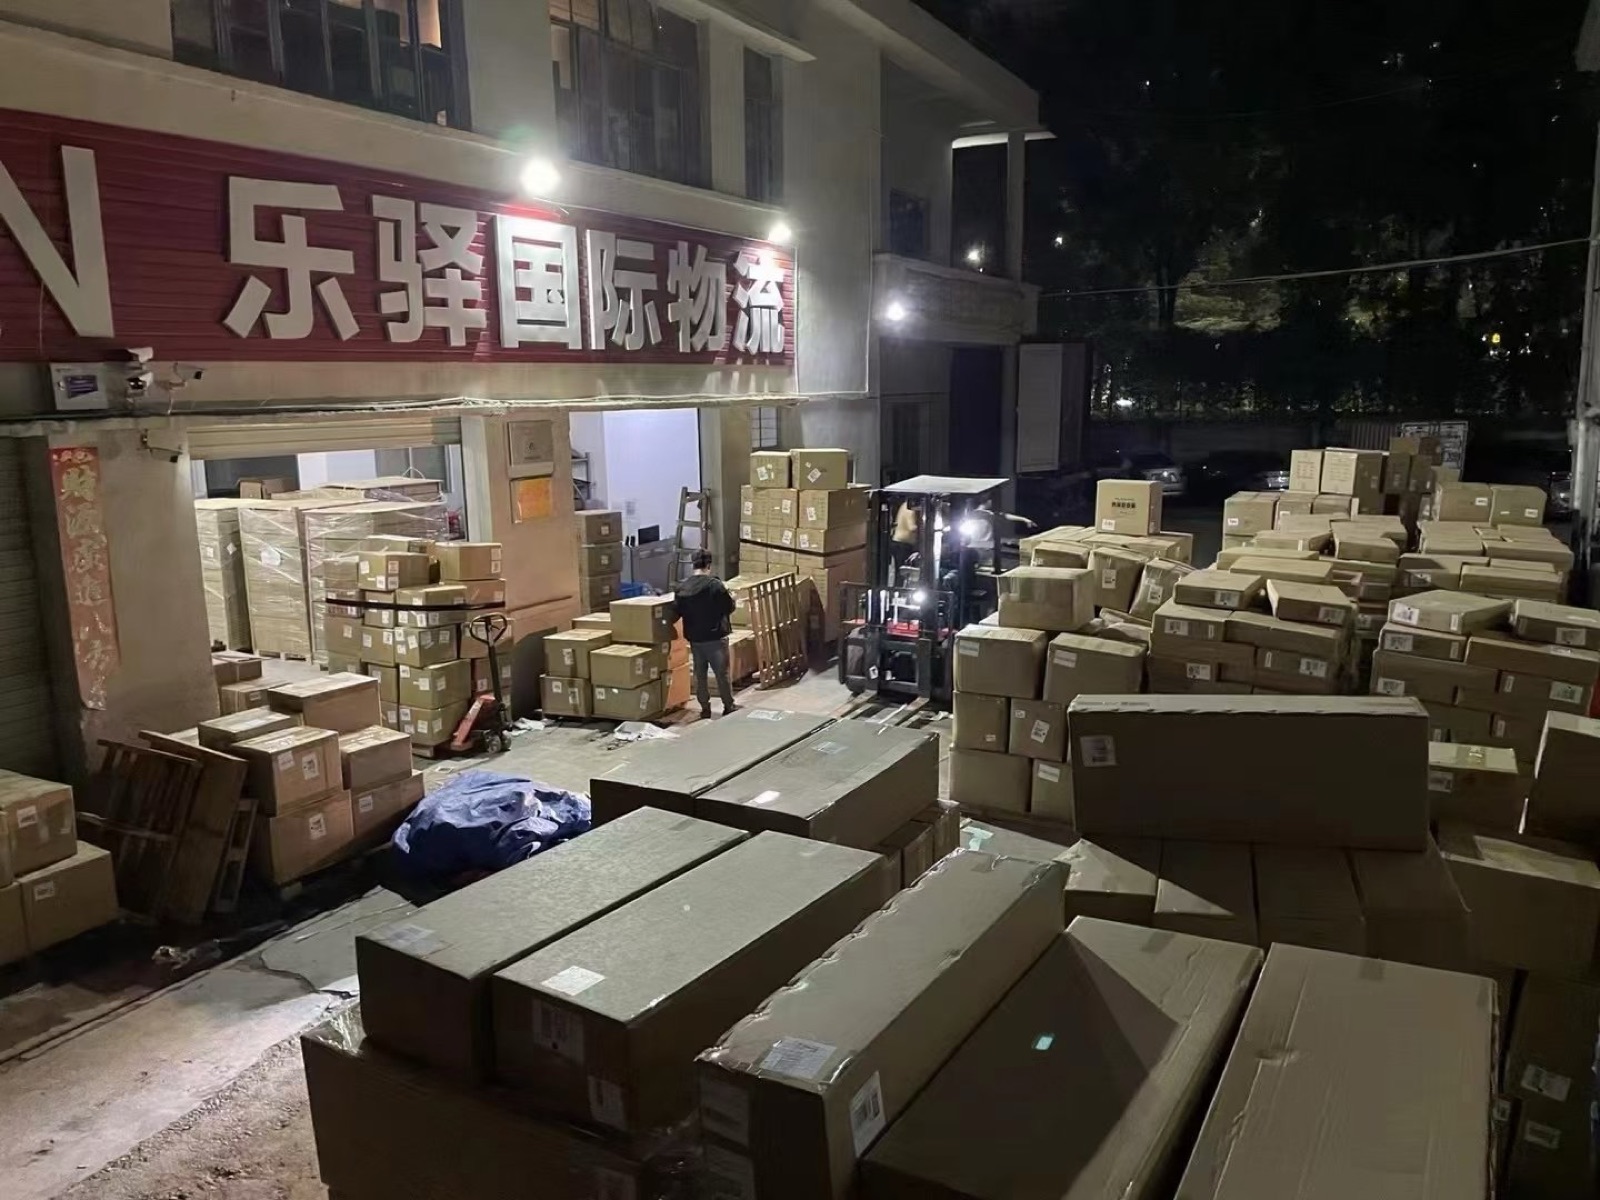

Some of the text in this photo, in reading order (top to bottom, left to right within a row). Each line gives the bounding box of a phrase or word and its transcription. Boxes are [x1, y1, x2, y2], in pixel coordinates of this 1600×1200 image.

[222, 175, 786, 354] 乐驿国际物流
